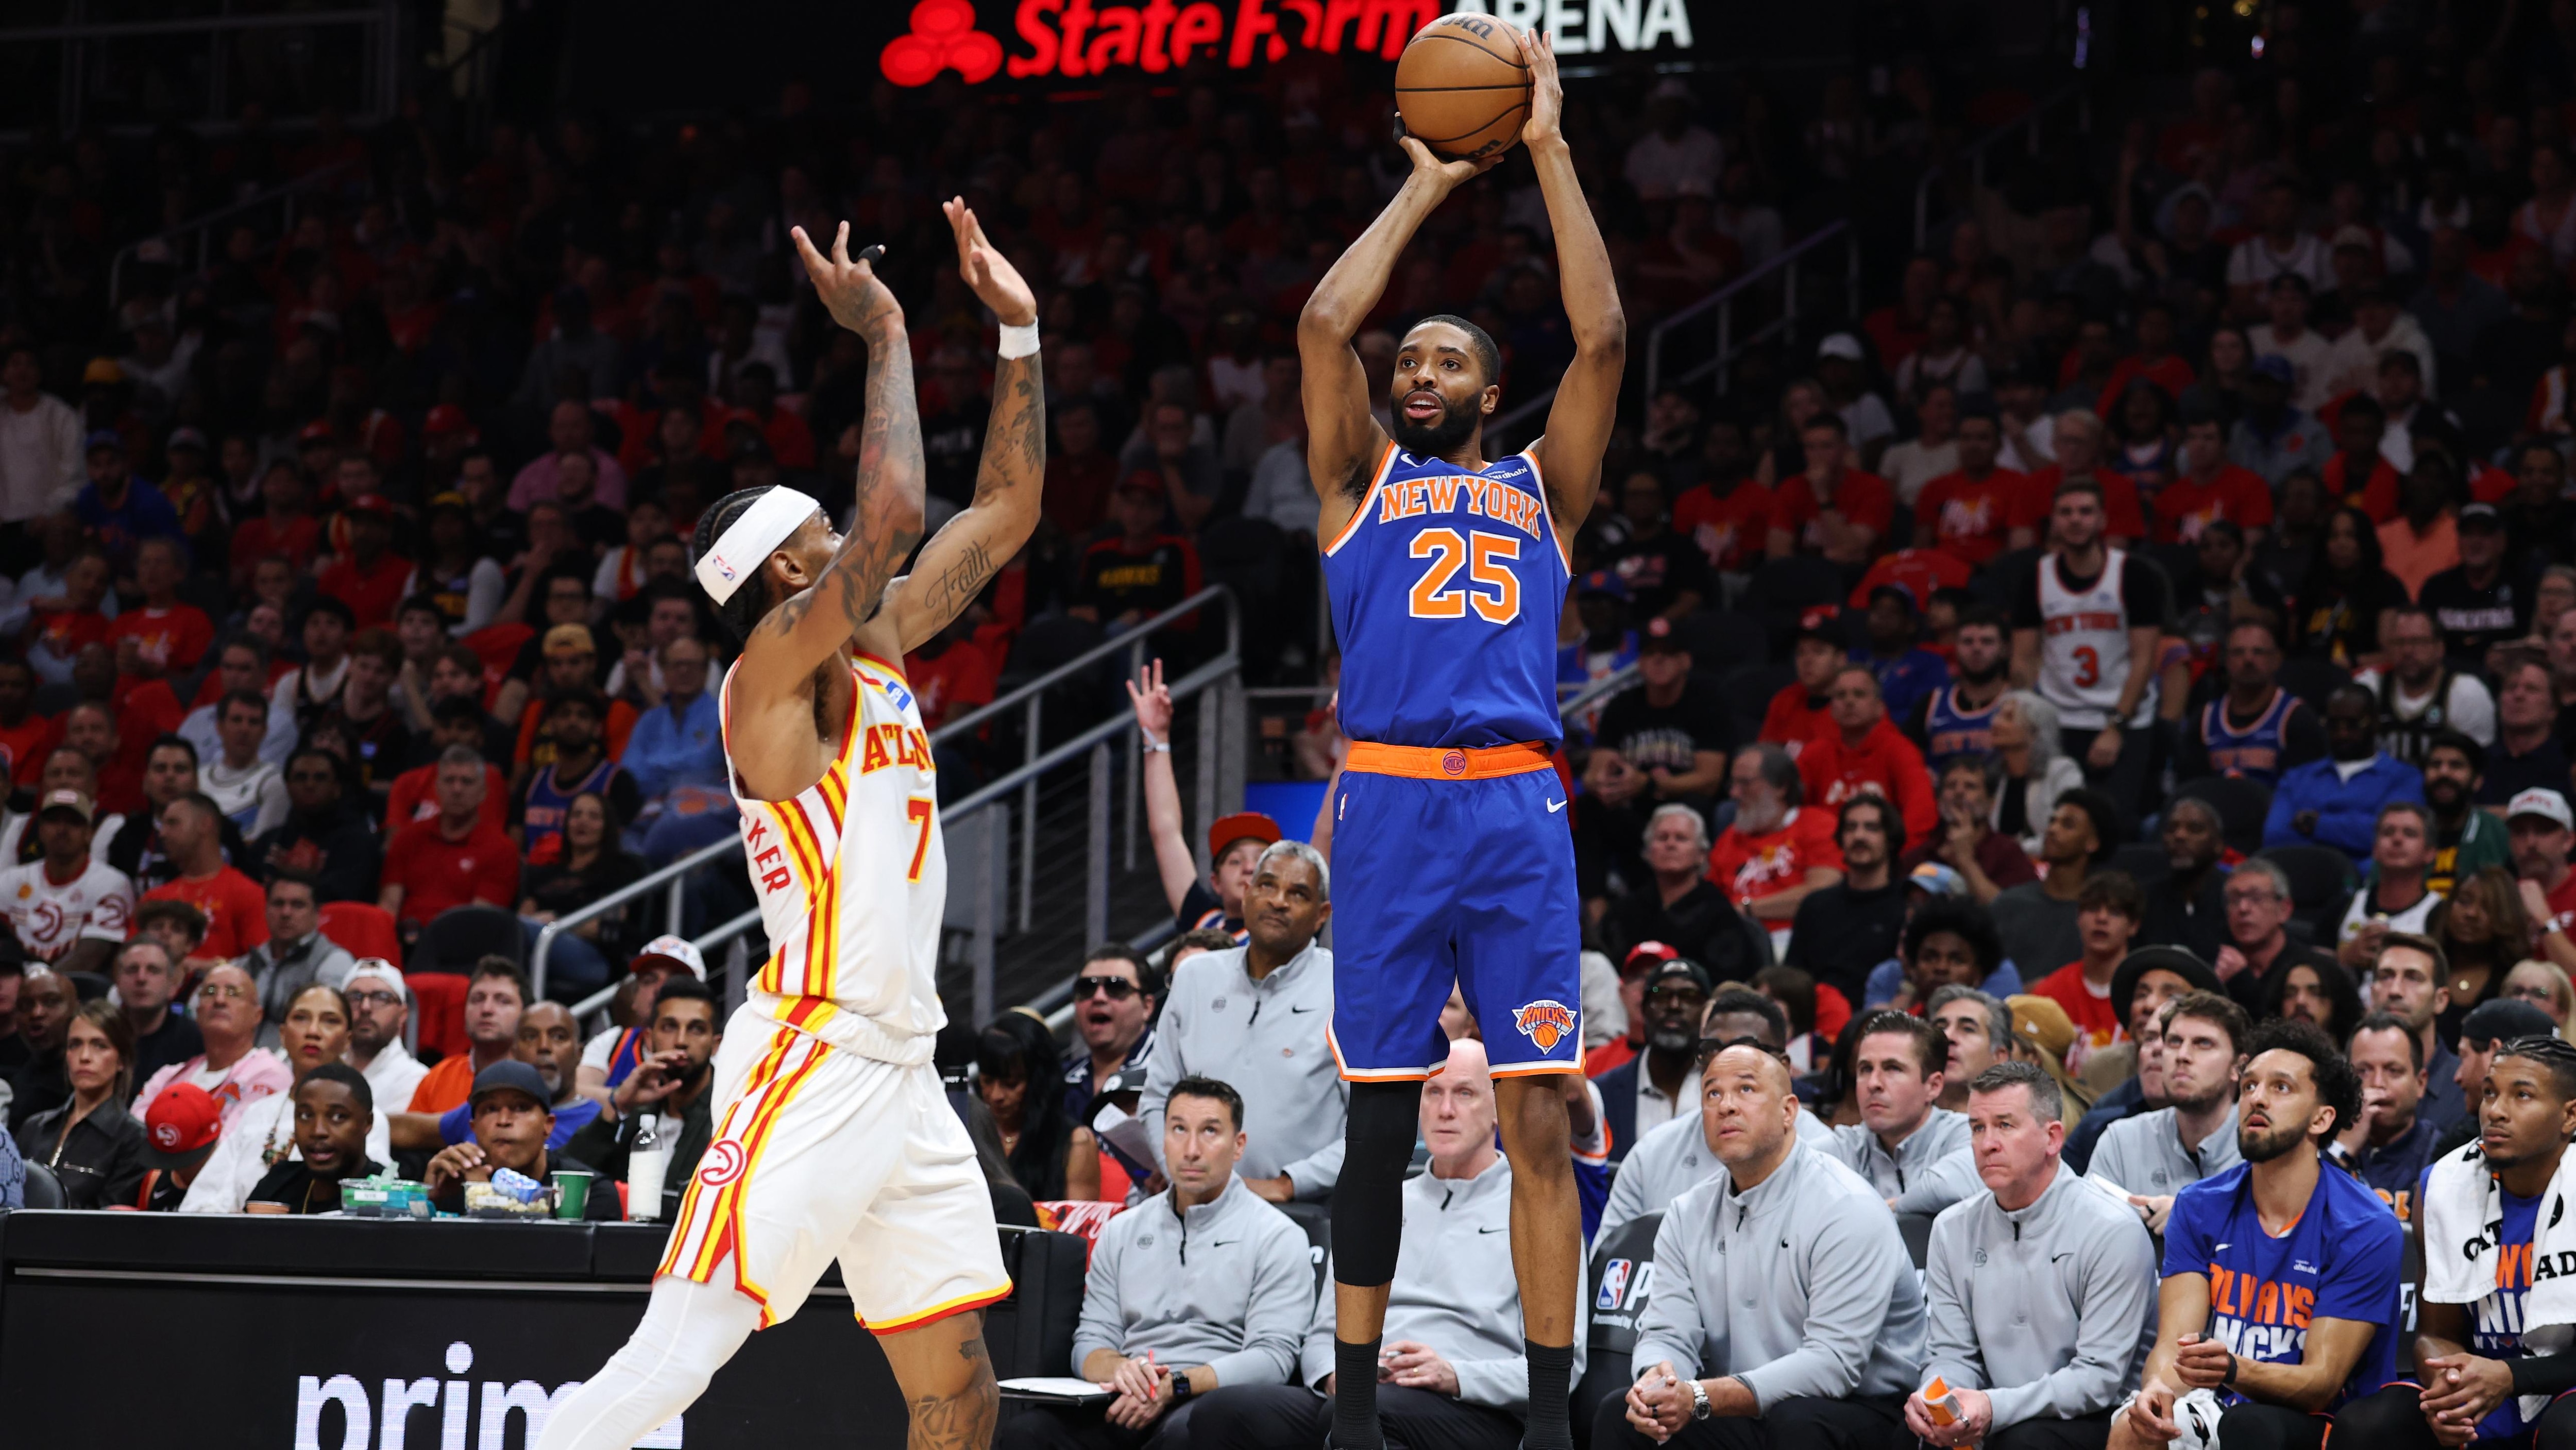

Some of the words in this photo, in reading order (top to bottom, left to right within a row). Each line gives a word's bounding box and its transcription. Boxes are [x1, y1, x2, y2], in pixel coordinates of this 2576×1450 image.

[1007, 0, 1223, 78] State
[1453, 0, 1694, 54] RENA
[1379, 475, 1462, 525] NEW
[1462, 474, 1542, 543] YORK
[925, 534, 998, 619] Faith
[1409, 528, 1520, 626] 25
[2073, 645, 2099, 688] 3
[737, 806, 791, 896] KER
[907, 796, 934, 885] 7
[1518, 1005, 1572, 1029] KNICKS
[294, 1341, 684, 1450] prim
